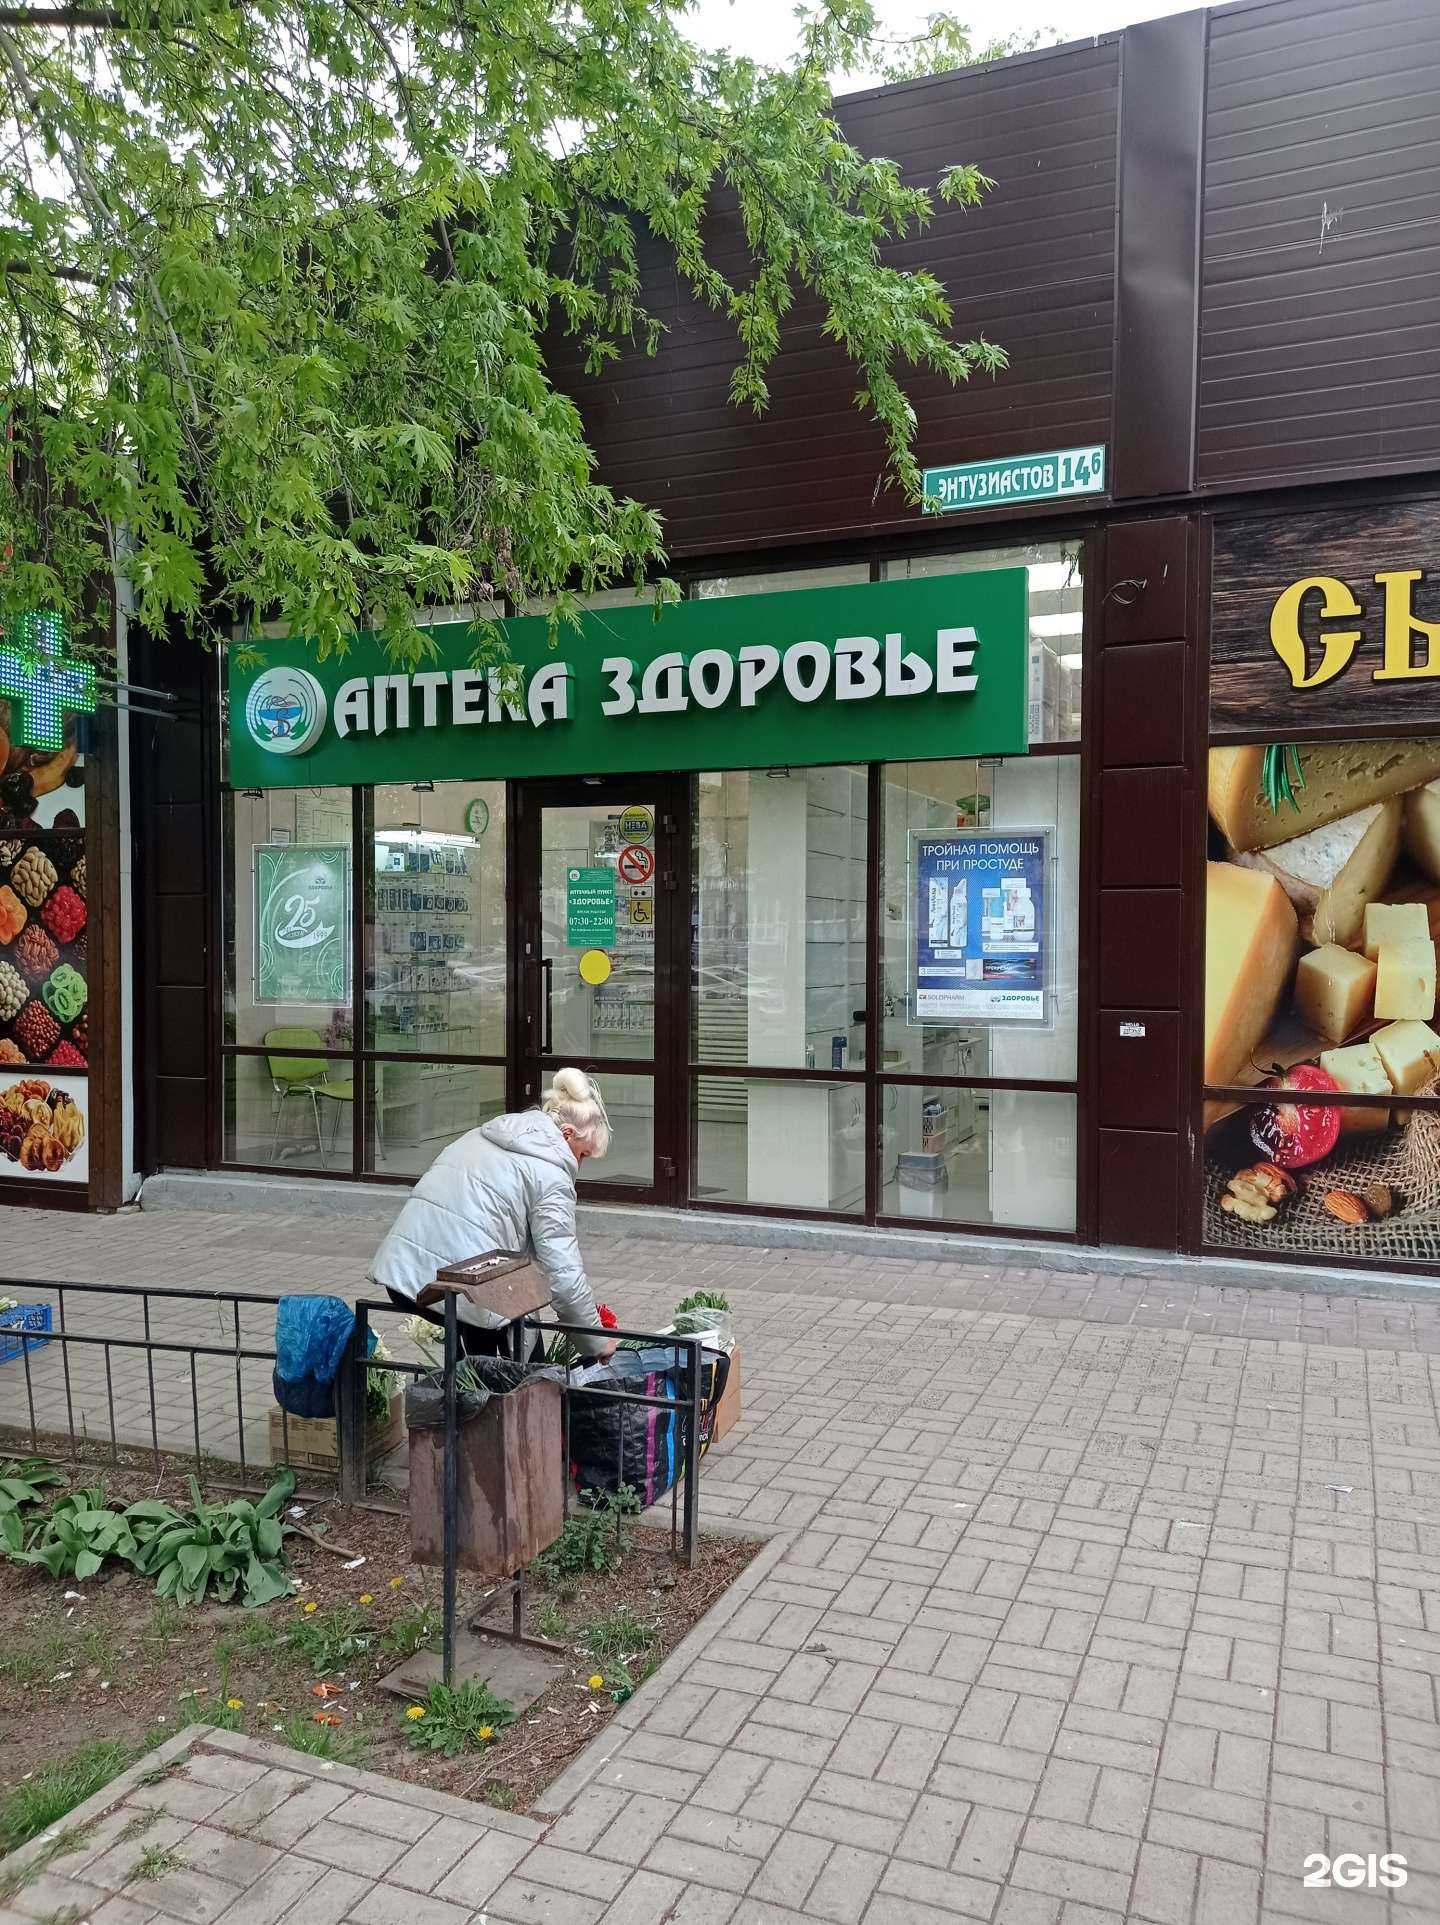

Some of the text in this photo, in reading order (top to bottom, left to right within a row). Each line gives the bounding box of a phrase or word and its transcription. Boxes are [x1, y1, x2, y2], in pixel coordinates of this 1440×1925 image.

[937, 464, 1054, 503] ЭНТУЗИАСТОВ
[334, 626, 979, 739] АПТЕКА ЗДОРОВЬЕ
[922, 842, 1040, 857] ТРОЙНАЯ ПОМОЩЬ
[936, 858, 1025, 871] ПРИ ПРОСТУДЕ
